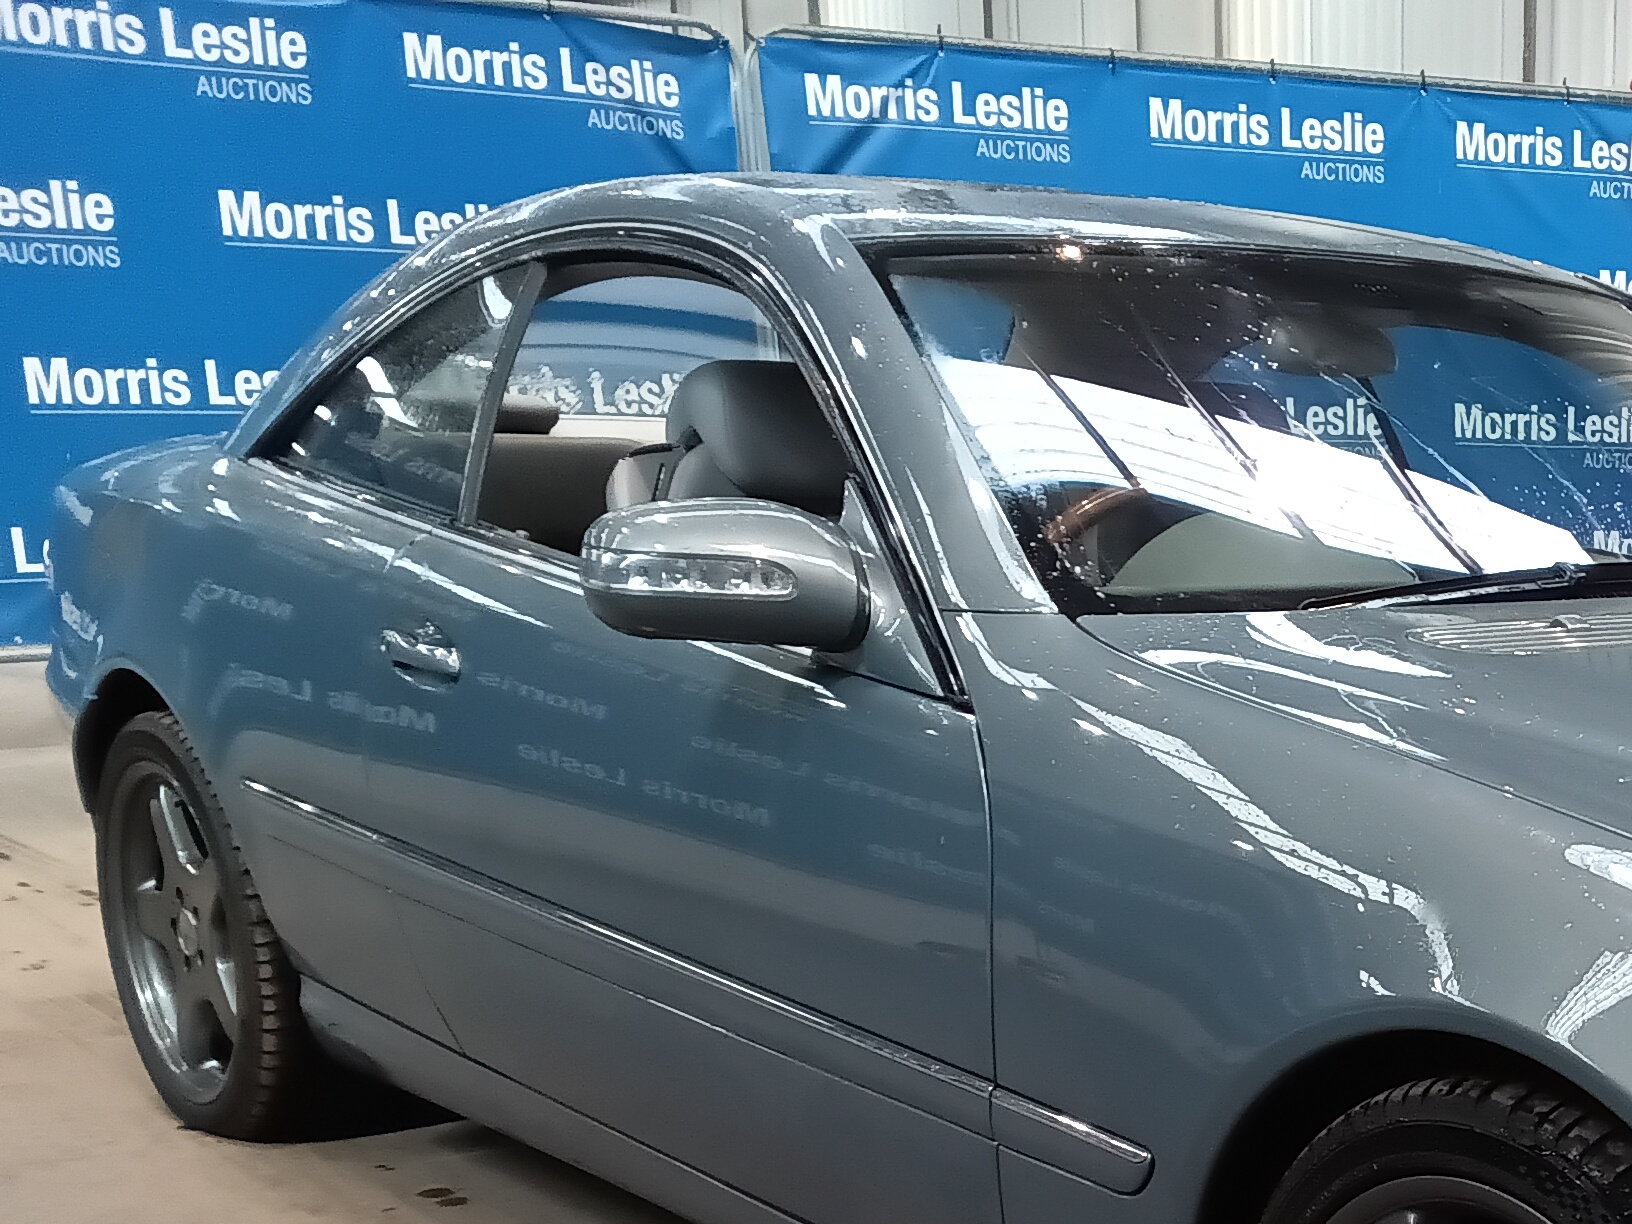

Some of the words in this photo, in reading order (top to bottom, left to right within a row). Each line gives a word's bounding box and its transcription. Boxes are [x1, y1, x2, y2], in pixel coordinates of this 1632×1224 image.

[158, 7, 308, 69] Leslie
[196, 75, 313, 105] AUCTIONS
[402, 32, 548, 91] Morris
[561, 48, 680, 108] Leslie
[587, 109, 685, 141] AUCTIONS
[803, 72, 940, 122] Morris
[952, 80, 1070, 132] Leslie
[1148, 96, 1270, 147] Morris
[1281, 107, 1386, 155] Leslie
[976, 138, 1072, 165] AUCTIONS
[1455, 120, 1565, 168] Morris
[1300, 159, 1386, 185] AUCTIONS
[0, 179, 115, 232] eslie
[217, 188, 375, 244] Morris
[22, 355, 192, 408] Morris
[1454, 401, 1557, 442] Morris
